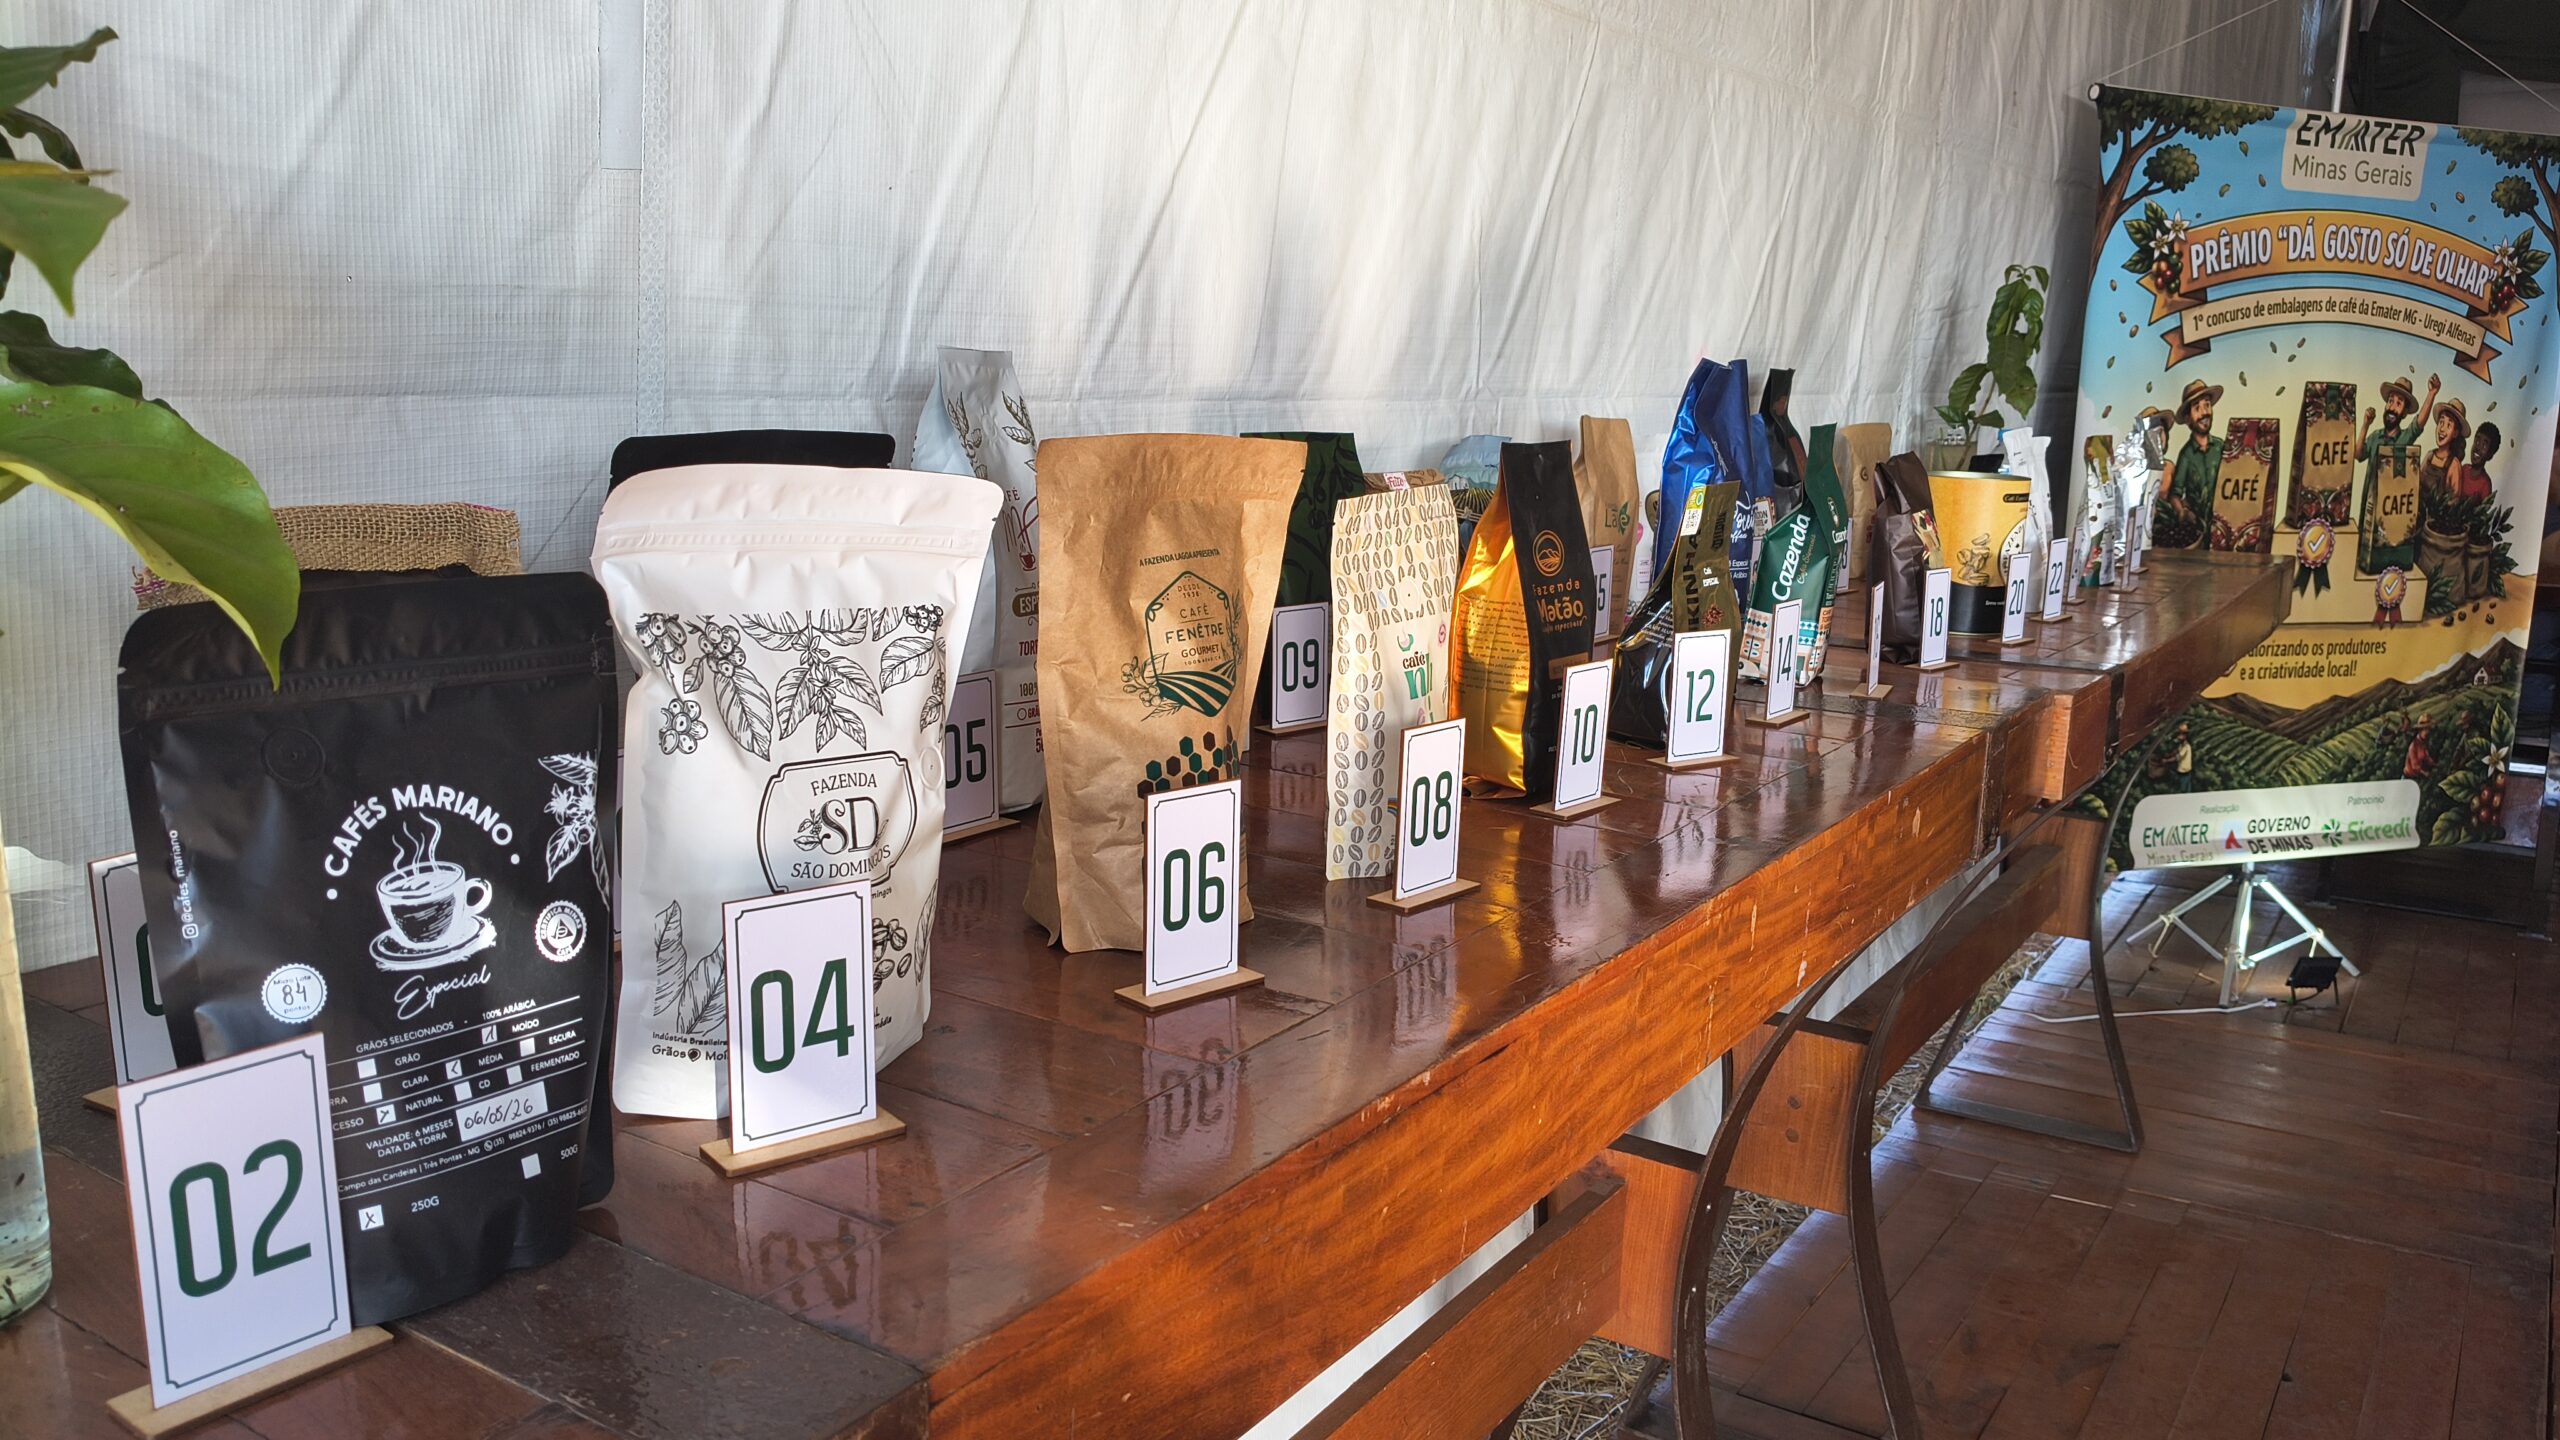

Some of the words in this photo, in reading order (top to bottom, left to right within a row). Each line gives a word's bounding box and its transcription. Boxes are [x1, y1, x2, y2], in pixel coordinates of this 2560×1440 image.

[2296, 113, 2426, 157] EMATER
[2292, 153, 2347, 181] Minas
[2355, 160, 2412, 188] Gerais
[2190, 228, 2272, 280] PRÊMIO
[2323, 223, 2381, 264] GOSTO
[2383, 228, 2411, 269] SÓ
[2411, 237, 2436, 276] DE
[2206, 304, 2250, 328] concurso
[2253, 300, 2265, 317] de
[2267, 295, 2323, 316] embalagens
[2325, 295, 2337, 312] de
[2338, 294, 2357, 314] café
[2358, 298, 2369, 315] da
[2370, 300, 2401, 321] Emater
[2403, 308, 2418, 325] MG
[2423, 315, 2446, 336] Uregi
[2446, 321, 2476, 347] Alfenas
[2311, 436, 2349, 466] CAFÉ
[1004, 486, 1020, 502] FÉ
[2221, 474, 2259, 501] CAFÉ
[2382, 489, 2414, 516] CAFÉ
[1144, 554, 1175, 566] FAZENDA
[1175, 551, 1192, 560] LAGOA
[1192, 548, 1220, 558] APRESENTA
[1771, 514, 1811, 600] Cazenda
[1533, 578, 1580, 596] Fazenda
[2049, 562, 2063, 595] 22
[1179, 604, 1210, 619] CAFÉ
[1537, 596, 1584, 623] Matão
[2009, 579, 2025, 616] 20
[1166, 621, 1224, 645] FENÊTRE
[1930, 597, 1944, 637] 18
[1181, 643, 1219, 658] GOURMET
[1402, 651, 1426, 669] café
[1777, 634, 1793, 684] 14
[2248, 639, 2308, 658] alorizando
[2312, 643, 2324, 656] os
[2326, 638, 2387, 659] produtores
[1282, 639, 1319, 692] 09
[2240, 671, 2246, 680] e
[2248, 670, 2255, 680] a
[2257, 661, 2324, 680] criatividade
[2327, 660, 2358, 677] local!
[1686, 668, 1715, 723] 12
[1572, 704, 1598, 766] 10
[811, 772, 877, 796] FAZENDA
[820, 796, 880, 854] SD
[1411, 771, 1453, 847] 08
[2247, 815, 2311, 835] GOVERNO
[325, 797, 387, 877] CAFÉS
[392, 784, 513, 846] MARIANO
[2143, 823, 2209, 848] EMATER
[2249, 839, 2268, 855] DE
[2269, 835, 2314, 853] MINAS
[2347, 817, 2411, 843] Sicredi
[791, 861, 824, 879] SÃO
[829, 844, 891, 879] DOMINGOS
[1163, 841, 1225, 932] 06
[394, 965, 492, 1020] Especial
[356, 1037, 388, 1053] GRÃOS
[390, 1021, 454, 1047] SELECIONADOS
[482, 1008, 502, 1021] 100%
[503, 999, 536, 1016] ARÁBICA
[751, 958, 854, 1074] 04
[394, 1052, 421, 1067] GRÃO
[511, 1018, 539, 1033] MOÍDO
[652, 1032, 688, 1043] Indústria
[652, 1045, 686, 1058] Grãos
[705, 1050, 728, 1061] Moí
[330, 1096, 348, 1108] RRA
[402, 1075, 429, 1089] CLARA
[479, 1052, 503, 1066] MÉDIA
[548, 1030, 576, 1045] ESCURA
[332, 1117, 364, 1131] CESSO
[405, 1094, 443, 1111] NATURAL
[478, 1079, 490, 1089] CD
[531, 1051, 580, 1072] FERMENTADO
[464, 1097, 533, 1130] 06/05/26
[366, 1131, 414, 1150] VALIDADE:
[422, 1120, 454, 1135] MESSES
[377, 1146, 402, 1157] DATA
[403, 1141, 417, 1151] DA
[418, 1131, 447, 1146] TORRA
[560, 1144, 578, 1160] 500G
[338, 1181, 366, 1193] Campo
[368, 1173, 381, 1186] das
[383, 1167, 417, 1182] Candeias
[423, 1159, 438, 1170] Três
[439, 1152, 463, 1166] Pontas
[468, 1146, 481, 1155] MG
[169, 1139, 312, 1297] 02
[411, 1195, 440, 1213] 250G
